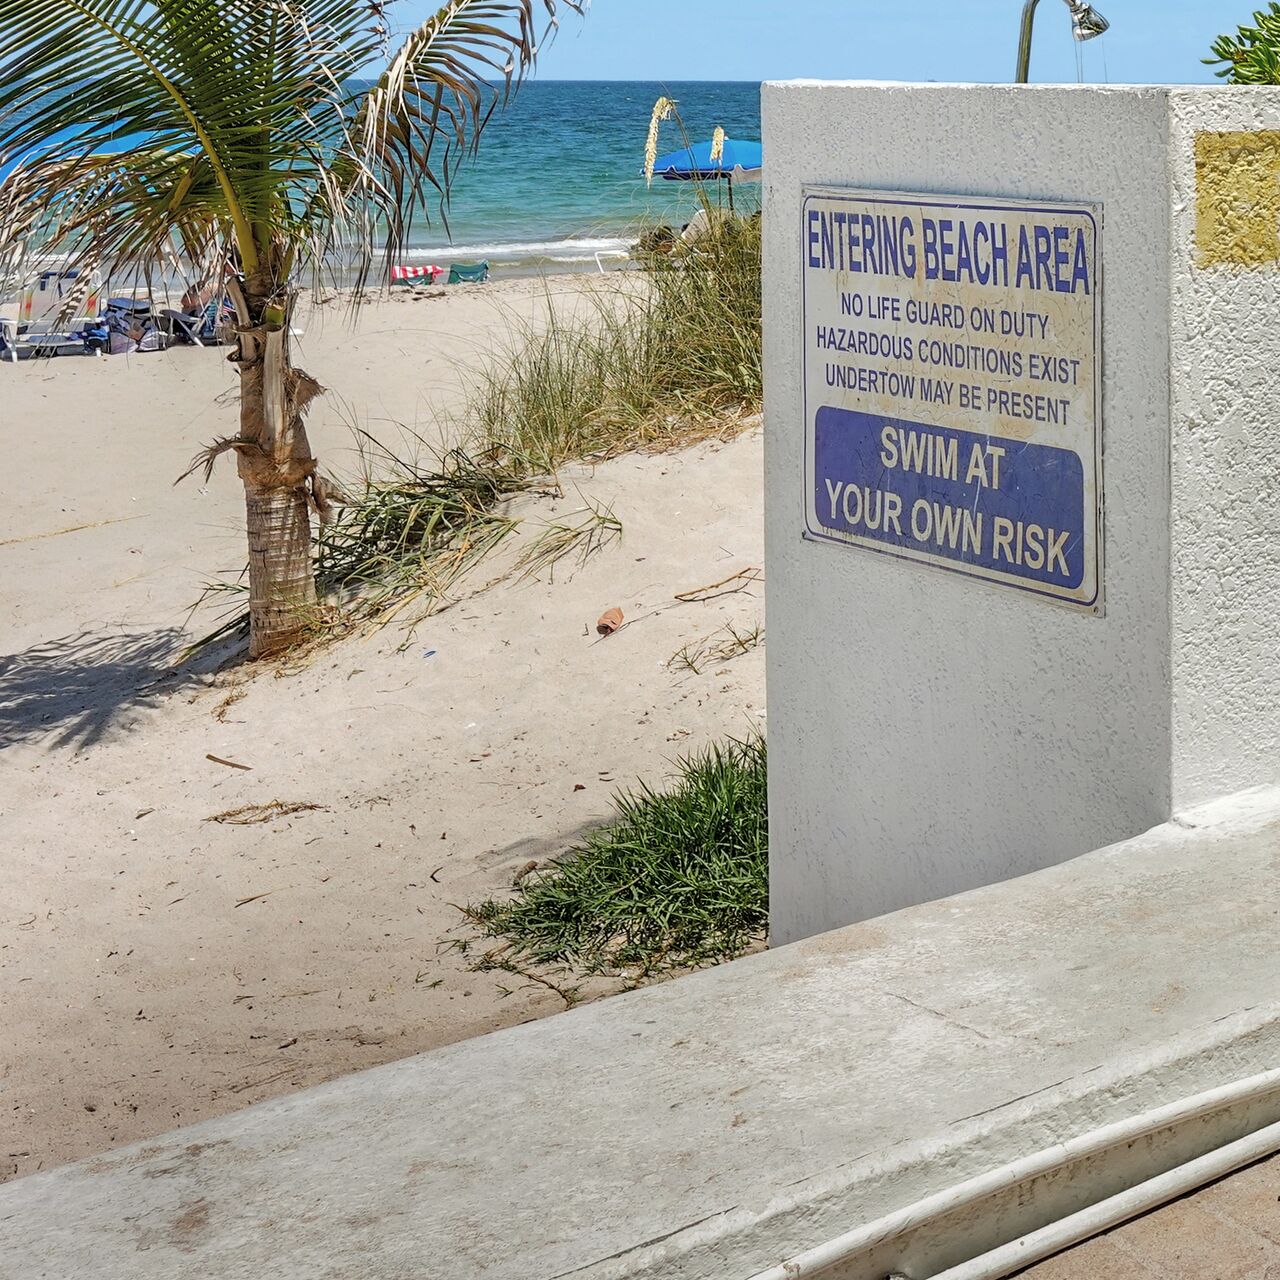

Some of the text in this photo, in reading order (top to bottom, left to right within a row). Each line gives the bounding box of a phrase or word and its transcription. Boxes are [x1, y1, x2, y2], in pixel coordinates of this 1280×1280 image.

[808, 210, 1090, 295] ENTERING BEACH AREA
[841, 292, 1049, 339] NO LIFE GUARD ON DUTY
[817, 326, 1080, 386] HAZARDOUS CONDITIONS EXIST
[825, 363, 1070, 425] UNDERTOW MAY BE PRESENT
[880, 426, 1005, 490] SWIM AT
[825, 478, 1070, 576] YOUR OWN RISK
